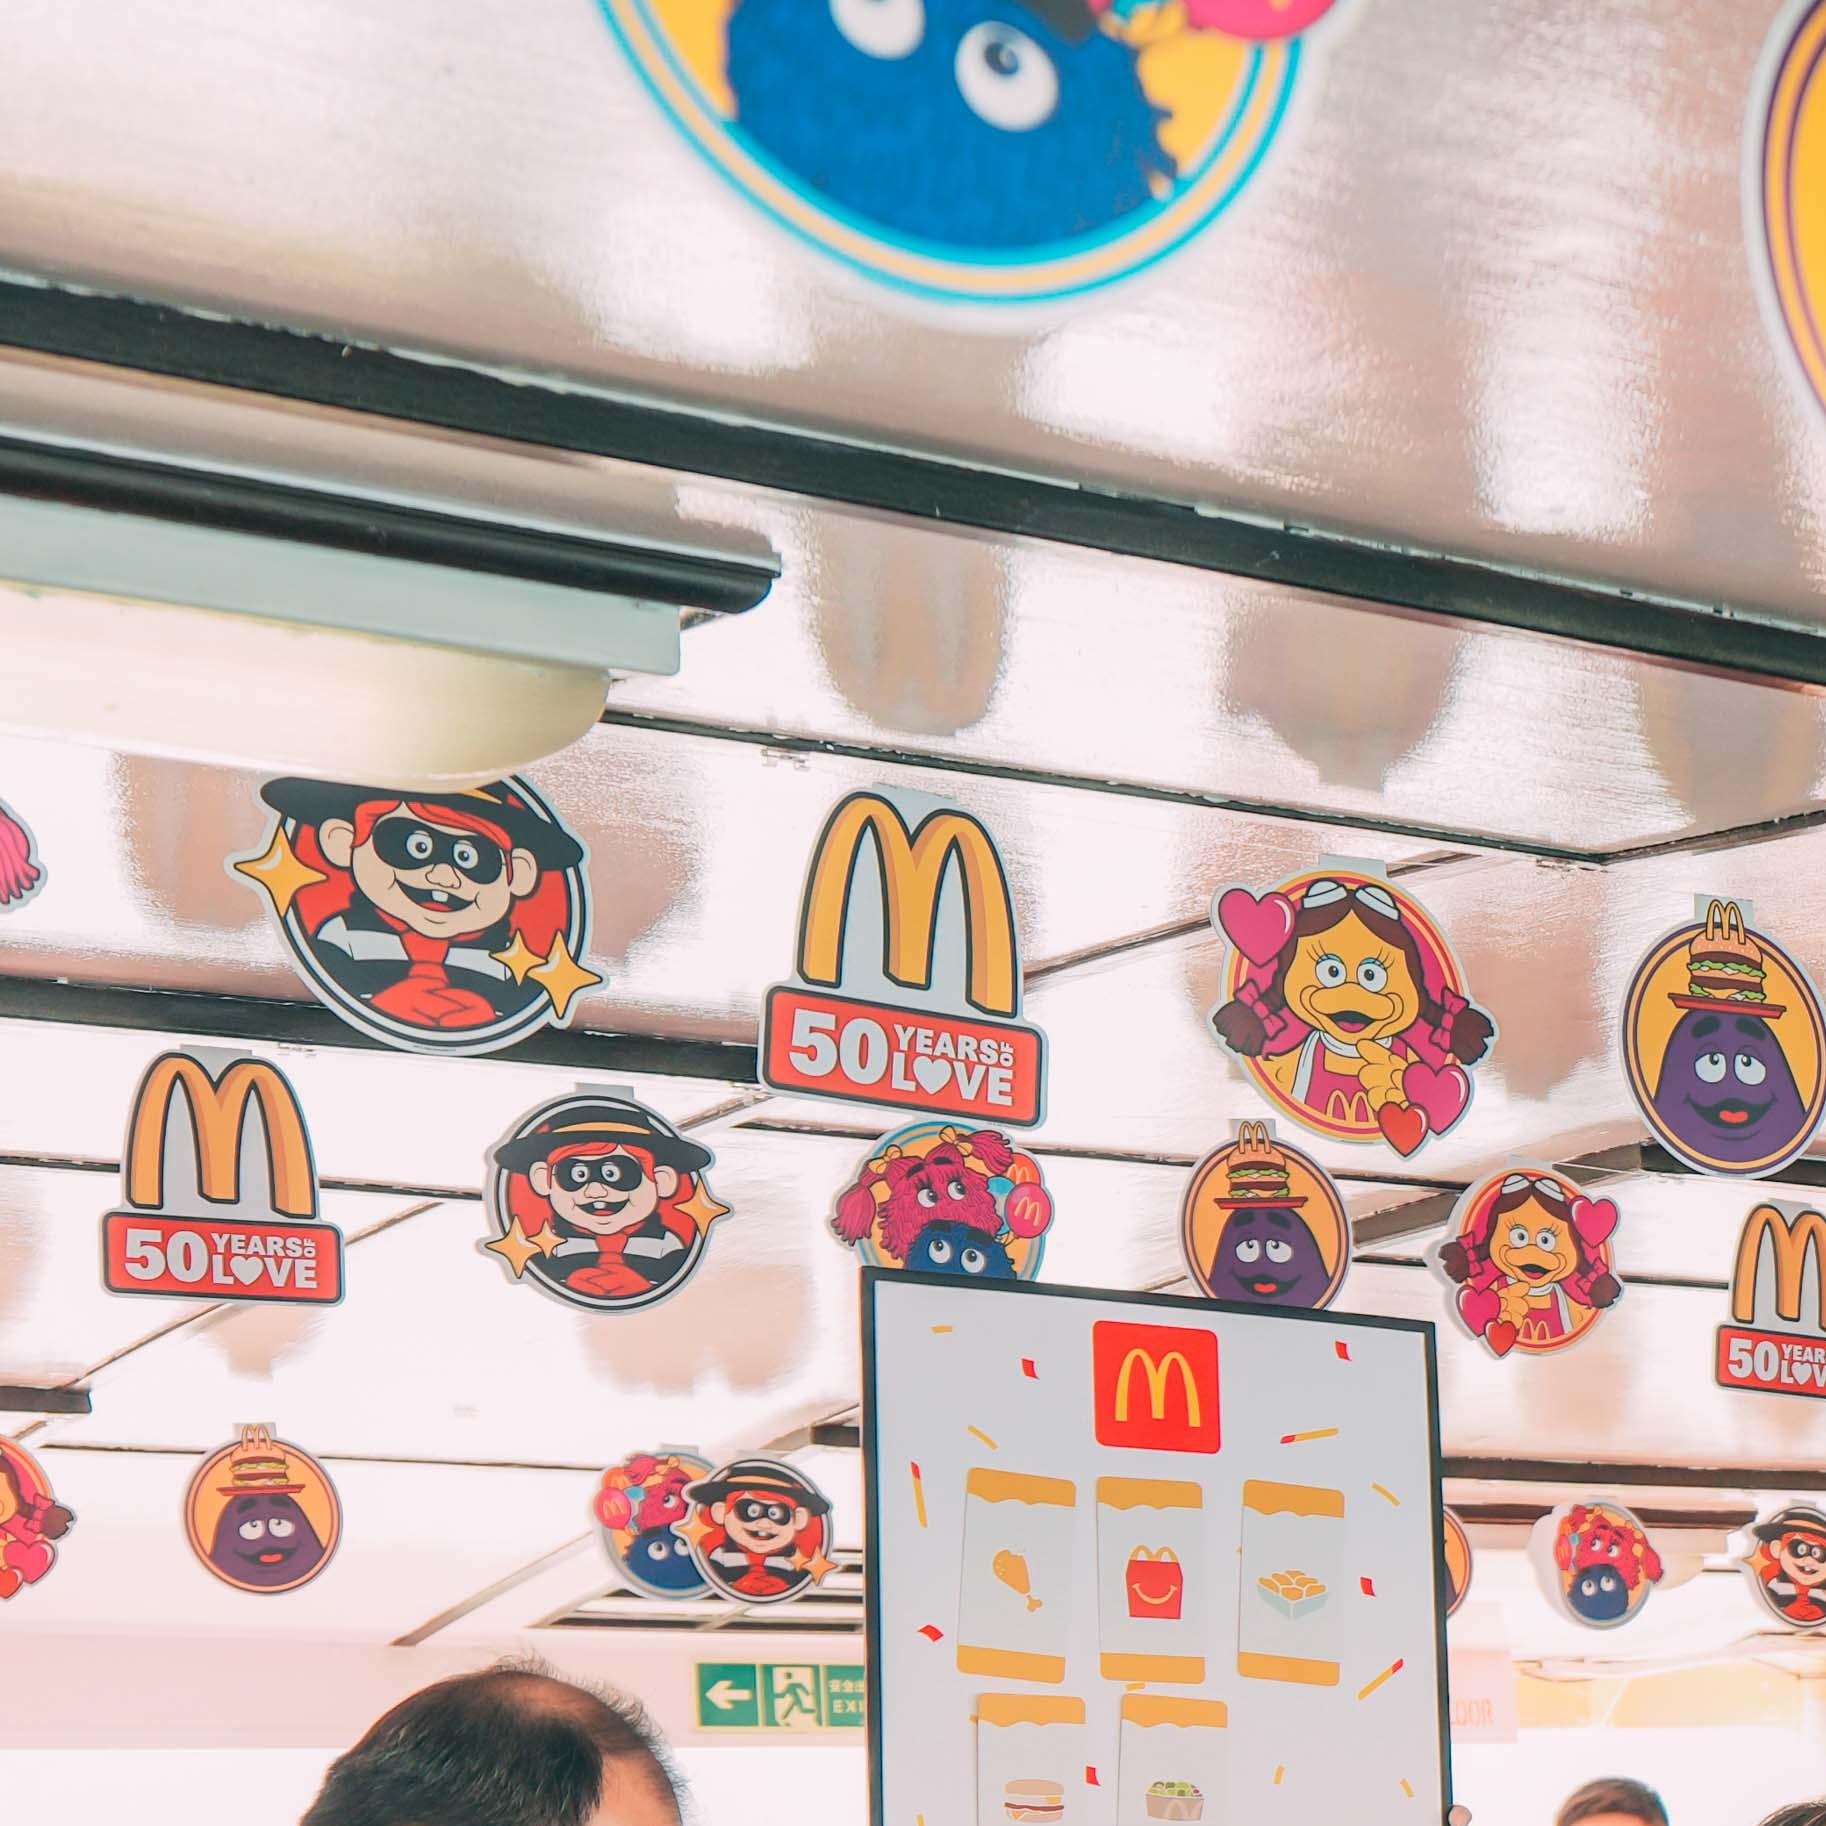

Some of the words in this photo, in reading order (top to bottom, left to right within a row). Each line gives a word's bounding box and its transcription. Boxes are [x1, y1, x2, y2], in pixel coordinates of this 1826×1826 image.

[788, 1007, 888, 1084] 50
[893, 1023, 1000, 1063] YEARS
[124, 1228, 210, 1283] 50
[212, 1233, 303, 1258] YEARS
[1728, 1338, 1779, 1381] 50
[832, 1699, 863, 1713] EXI
